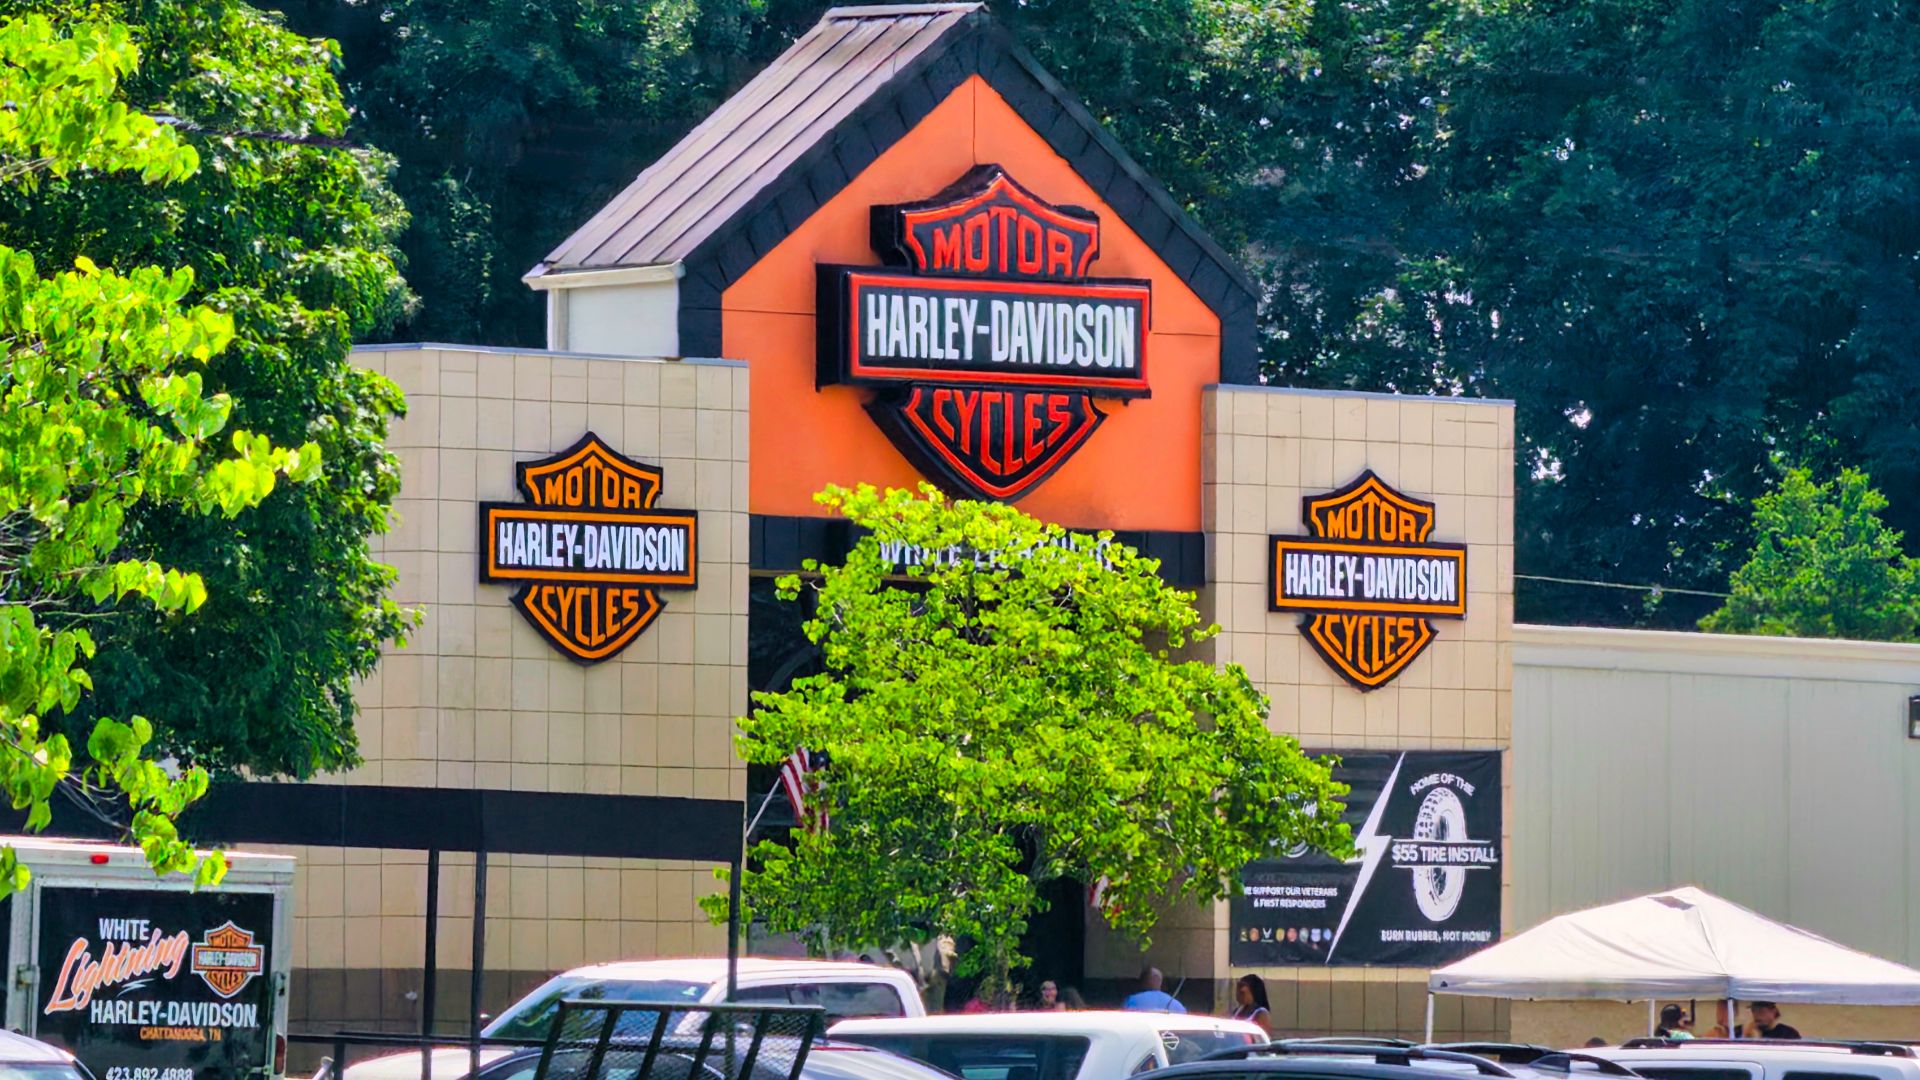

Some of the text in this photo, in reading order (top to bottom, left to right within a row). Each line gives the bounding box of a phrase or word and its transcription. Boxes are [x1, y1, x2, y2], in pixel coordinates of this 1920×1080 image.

[932, 206, 1072, 276] MOTOR
[867, 294, 1135, 367] HARLEY-DAVIDSON
[933, 389, 1072, 475] CYCLES
[544, 455, 640, 509] MOTOR
[1327, 491, 1417, 542] MOTOR
[499, 521, 685, 571] HARLEY-DAVIDSON
[1285, 553, 1456, 601] HARLEY-DAVIDSON
[541, 586, 639, 647] CYCLES
[1325, 615, 1415, 673] CYCLES
[1410, 773, 1475, 797] HOME OF THE
[1392, 844, 1498, 863] $55 TIRE INSTALL
[98, 918, 151, 940] WHITE
[1381, 929, 1404, 942] BURN
[1442, 930, 1460, 942] NOT
[44, 928, 189, 1015] Lightning
[91, 999, 258, 1027] HARLEY-DAVIDSON
